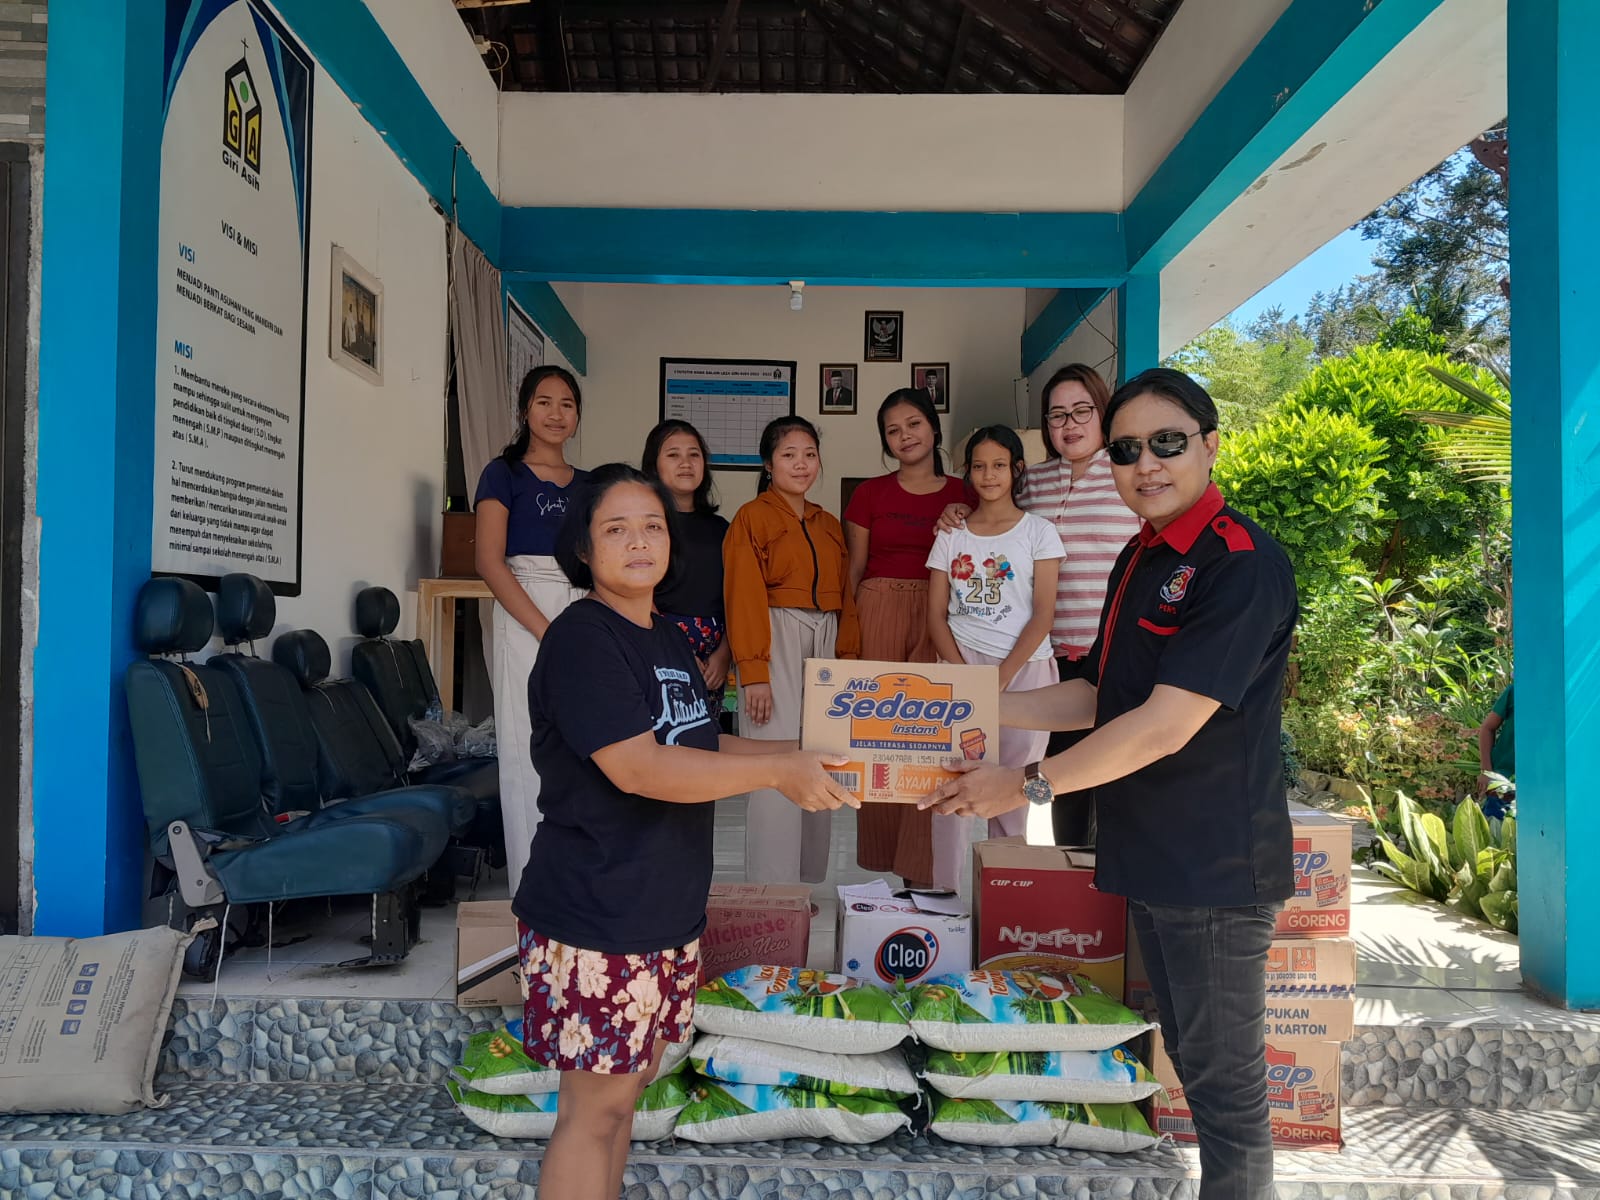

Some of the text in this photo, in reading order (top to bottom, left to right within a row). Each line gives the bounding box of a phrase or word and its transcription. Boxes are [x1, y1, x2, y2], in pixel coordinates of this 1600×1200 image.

[229, 109, 257, 160] G A
[222, 151, 260, 192] Giri Asih
[221, 220, 258, 257] VISI & MISI
[178, 242, 195, 264] VISI
[176, 268, 203, 289] MENJADI
[204, 283, 220, 300] PANTI
[220, 293, 241, 312] ASUHAN
[242, 305, 254, 320] YANG
[176, 284, 256, 335] MENJADI BERKAT BAGI SESAMA
[175, 340, 193, 360] MISI
[174, 382, 195, 397] mampu
[196, 391, 220, 408] sehingga
[181, 367, 210, 388] Membantu
[212, 382, 230, 396] mereka
[230, 391, 242, 403] yang
[172, 414, 202, 430] menengah
[173, 398, 204, 416] pendidikan
[206, 408, 216, 420] baik
[218, 414, 222, 423] di
[223, 415, 240, 429] tingkat
[172, 430, 184, 440] atas
[179, 462, 193, 474] Turut
[194, 468, 225, 485] mendukung
[171, 475, 180, 486] hal
[181, 480, 219, 496] mencerdaskan
[238, 492, 254, 506] dengan
[171, 494, 205, 508] memberikan
[170, 508, 180, 518] dari
[183, 510, 206, 525] keluarga
[207, 517, 220, 528] yang
[170, 526, 200, 539] menempuh
[169, 540, 192, 552] minimal
[965, 577, 1001, 605] 23
[847, 679, 879, 692] Mie
[826, 693, 972, 727] Sedaap
[892, 724, 939, 735] Instant
[909, 743, 947, 751] SEDAPNYA
[895, 777, 931, 790] AYAM
[1288, 914, 1346, 928] GORENG
[703, 936, 790, 968] Combo New
[888, 943, 926, 968] Cleo
[113, 968, 135, 1024] BUATAN INDONESIA
[1266, 1008, 1310, 1019] PUKAN
[1275, 1024, 1327, 1035] KARTON
[1271, 1125, 1333, 1141] GORENG
